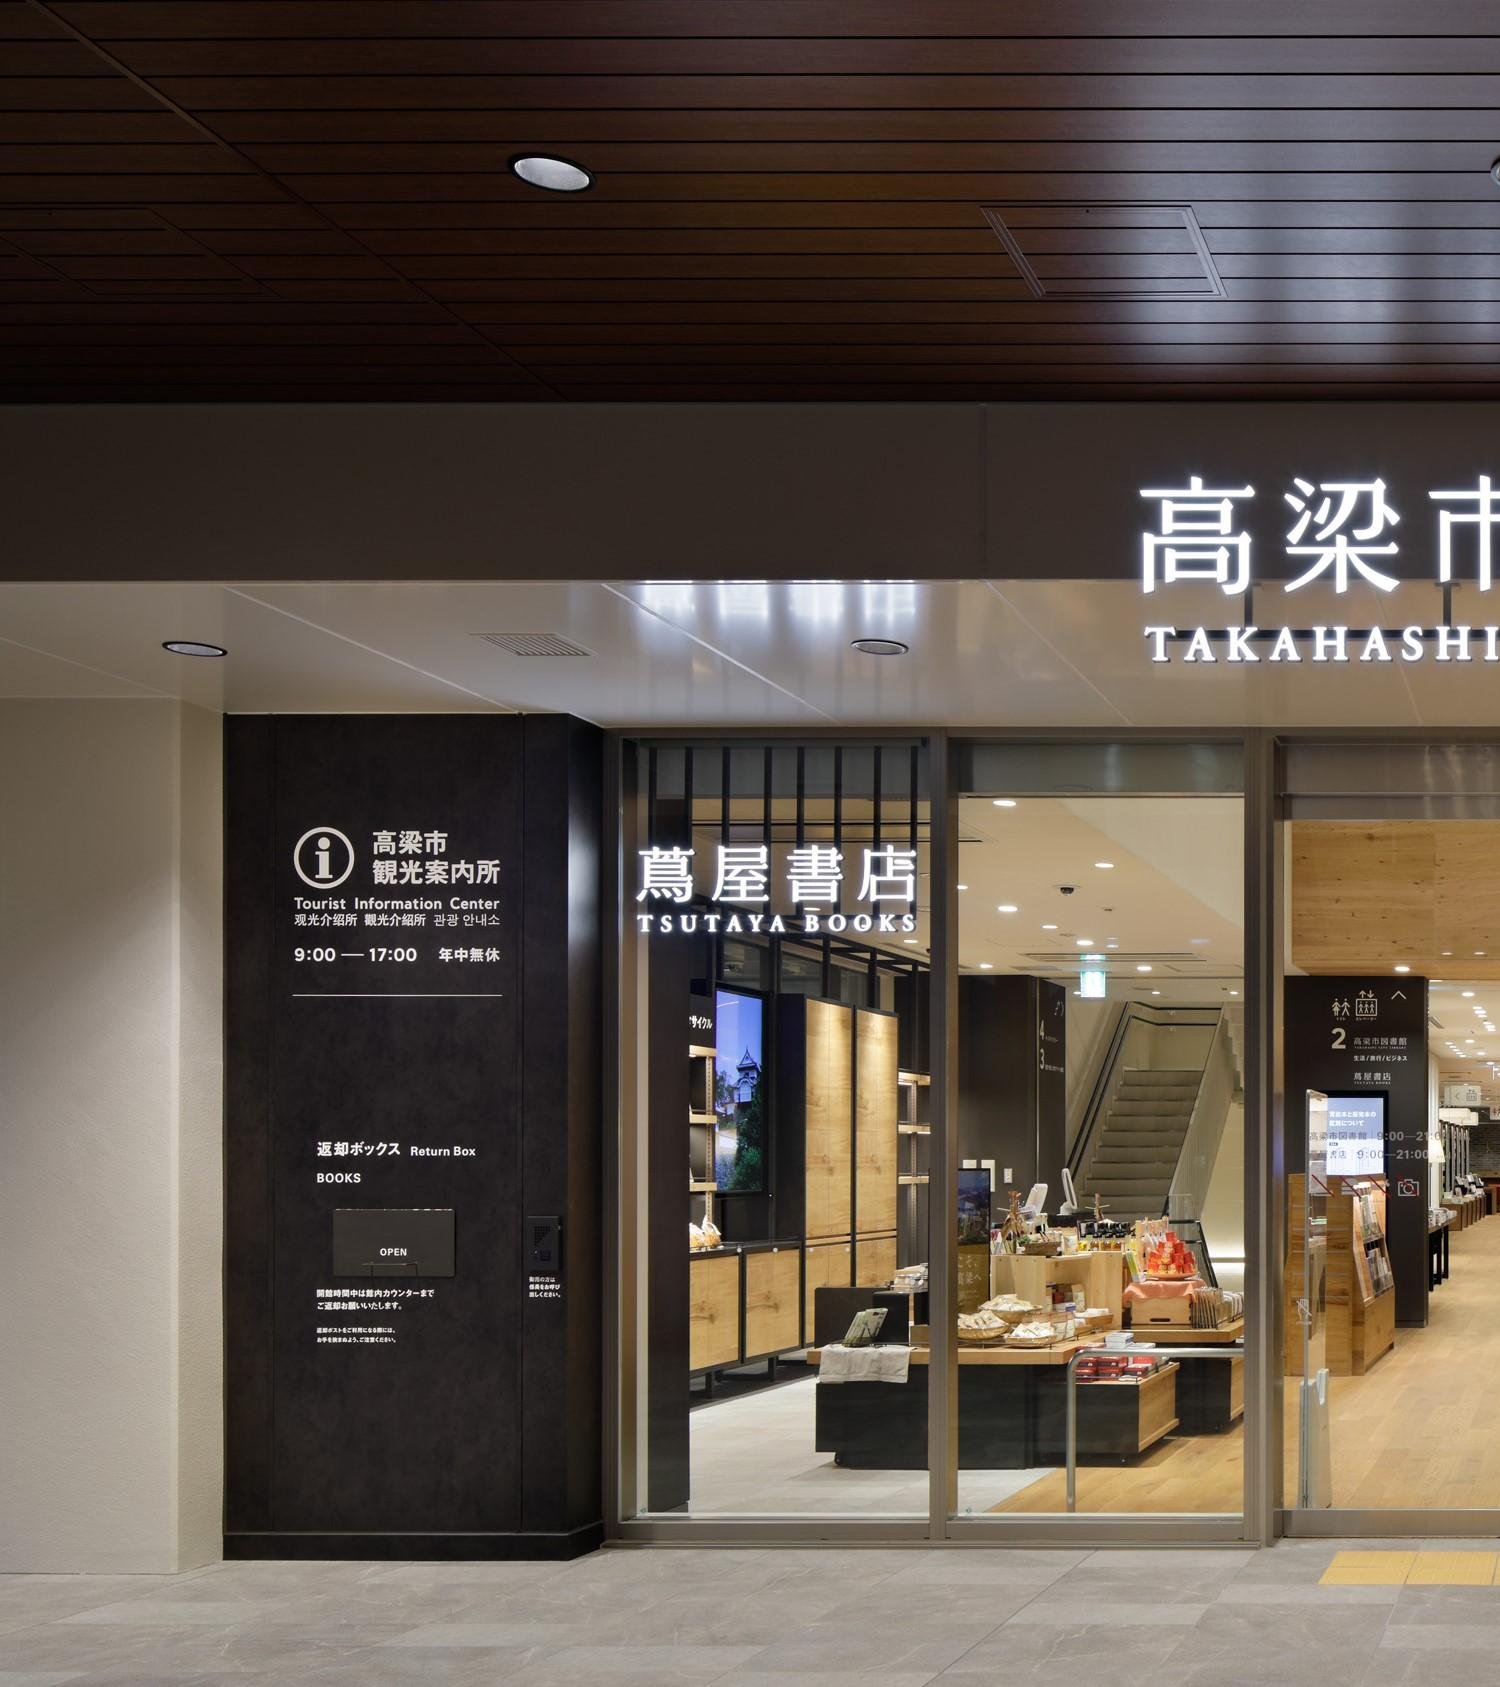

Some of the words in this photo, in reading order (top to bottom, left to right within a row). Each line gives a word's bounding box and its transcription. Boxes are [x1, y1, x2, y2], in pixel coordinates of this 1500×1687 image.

[372, 830, 449, 856] 高梁市
[372, 859, 501, 885] 観光案内所
[636, 844, 918, 904] 蔦屋書店
[294, 897, 346, 910] Tourist
[354, 897, 442, 910] Information
[450, 897, 500, 910] Center
[637, 913, 786, 933] TSUTAYA
[804, 913, 917, 933] BOOKS
[294, 947, 336, 962] 9:00
[369, 947, 417, 962] 17:00
[438, 947, 500, 962] 年中無休
[1331, 1027, 1346, 1049] 2
[1040, 1048, 1045, 1069] 3
[316, 1141, 401, 1157] 返却ボックス
[410, 1146, 451, 1157] Return
[453, 1146, 476, 1157] Box
[316, 1172, 362, 1184] BOOKS
[379, 1247, 408, 1257] OPEN
